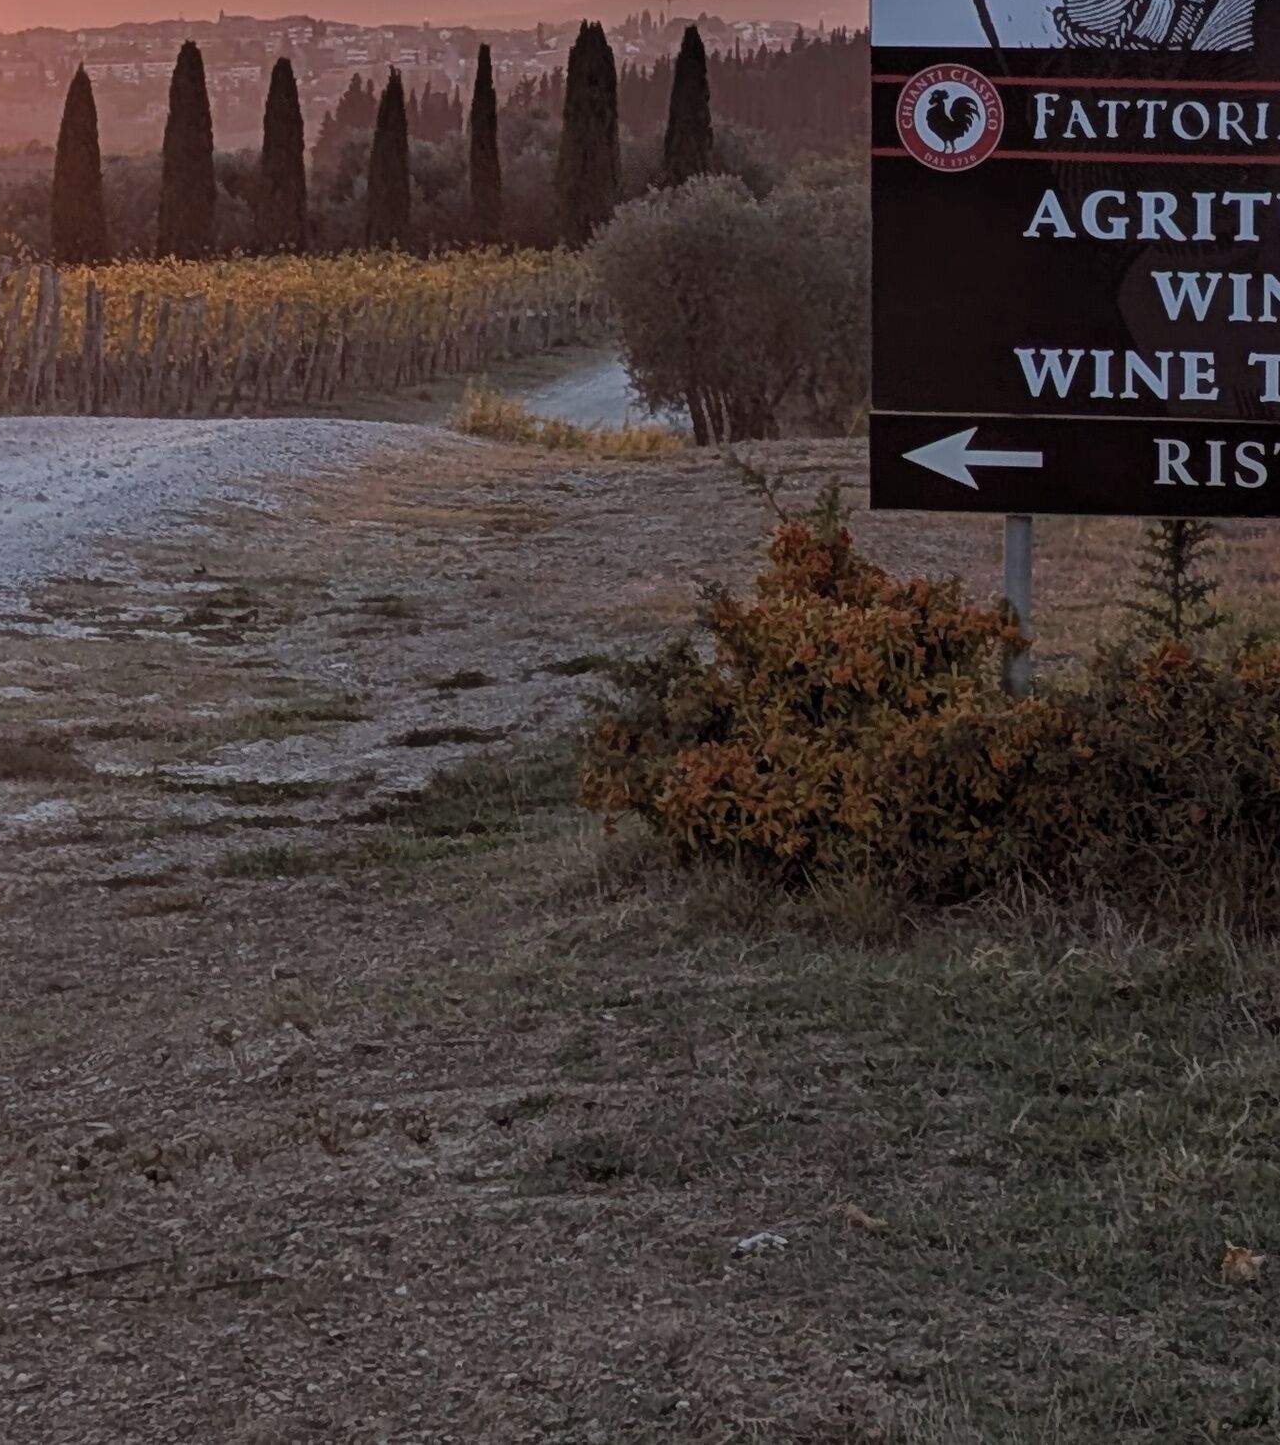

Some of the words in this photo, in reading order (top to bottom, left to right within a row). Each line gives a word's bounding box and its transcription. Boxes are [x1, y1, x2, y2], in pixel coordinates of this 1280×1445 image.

[902, 70, 942, 129] CHIANTI
[950, 69, 998, 131] CLASSICO
[924, 152, 945, 166] DAL
[1013, 347, 1220, 401] WINE
